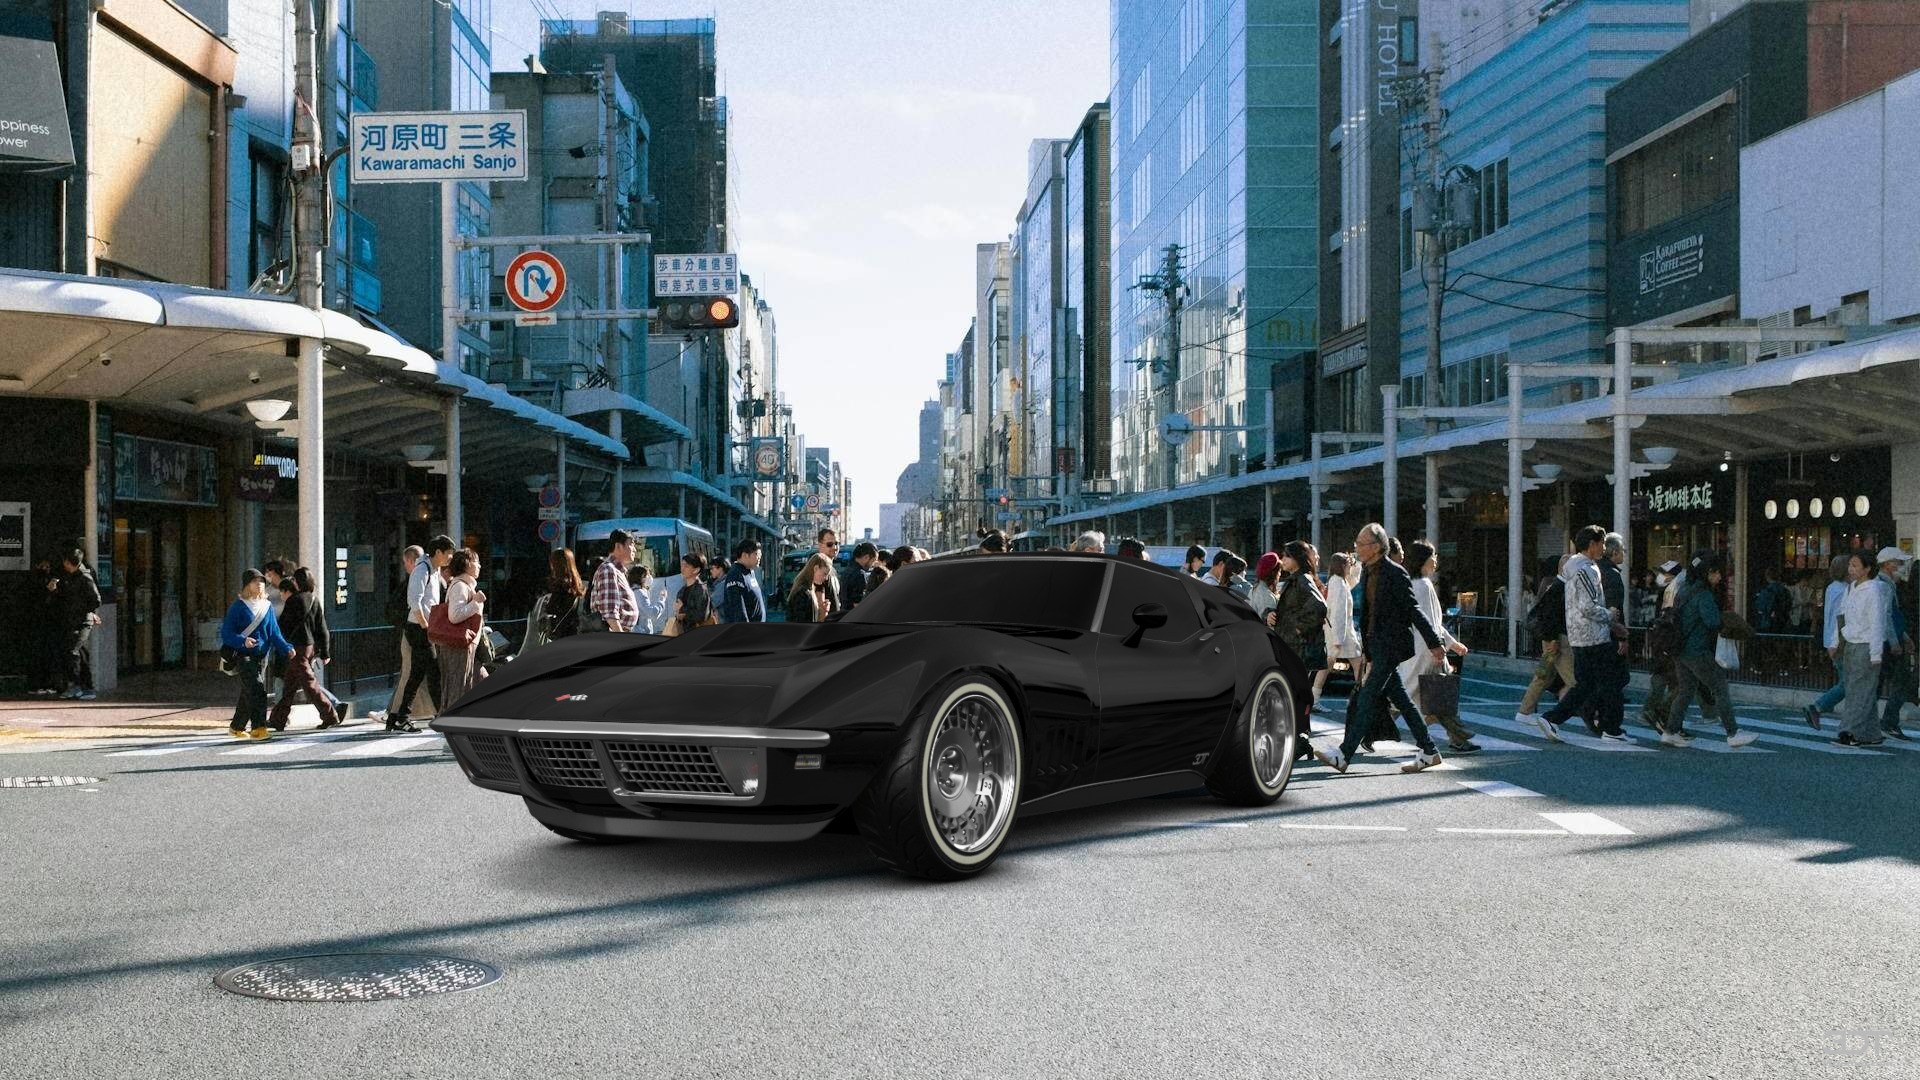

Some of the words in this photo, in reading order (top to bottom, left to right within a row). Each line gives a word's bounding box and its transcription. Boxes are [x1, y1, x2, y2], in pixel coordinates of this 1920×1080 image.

[1378, 23, 1398, 117] HOTEL
[360, 123, 449, 151] 河原町
[459, 122, 517, 150] 三条
[361, 155, 465, 171] Kawaramachi
[473, 154, 517, 171] Sanjo
[658, 257, 733, 272] 歩車分離信号
[659, 278, 734, 292] 時差式信号機
[761, 454, 775, 465] 40
